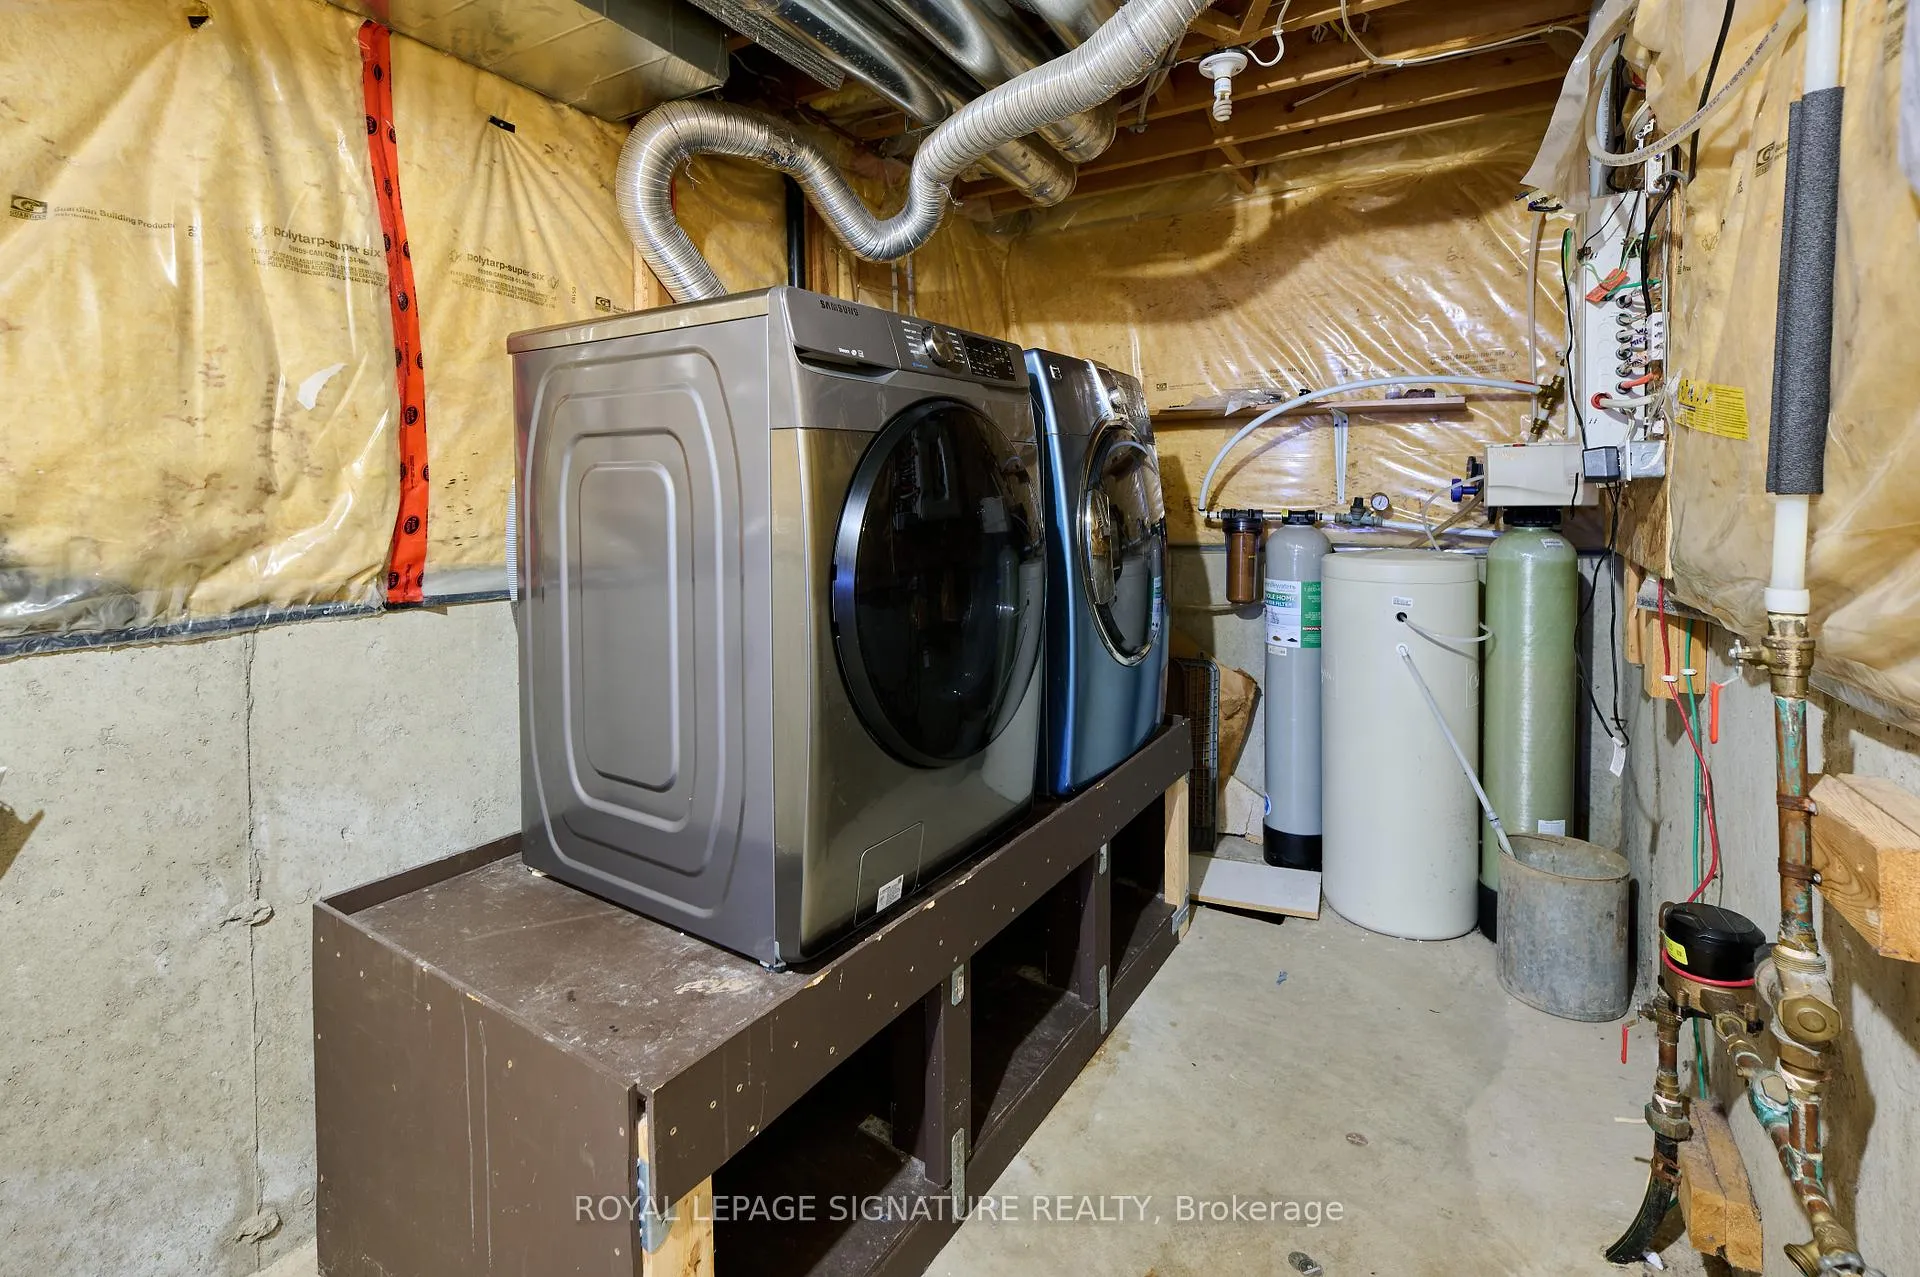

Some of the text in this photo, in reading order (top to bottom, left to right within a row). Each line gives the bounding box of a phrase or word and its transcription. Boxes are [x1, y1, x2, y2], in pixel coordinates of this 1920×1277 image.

[99, 209, 137, 226] Building
[137, 219, 176, 230] Products
[273, 226, 382, 258] polytarp-super six
[467, 252, 545, 281] polytarp-super six
[820, 299, 859, 317] SAMSUNG
